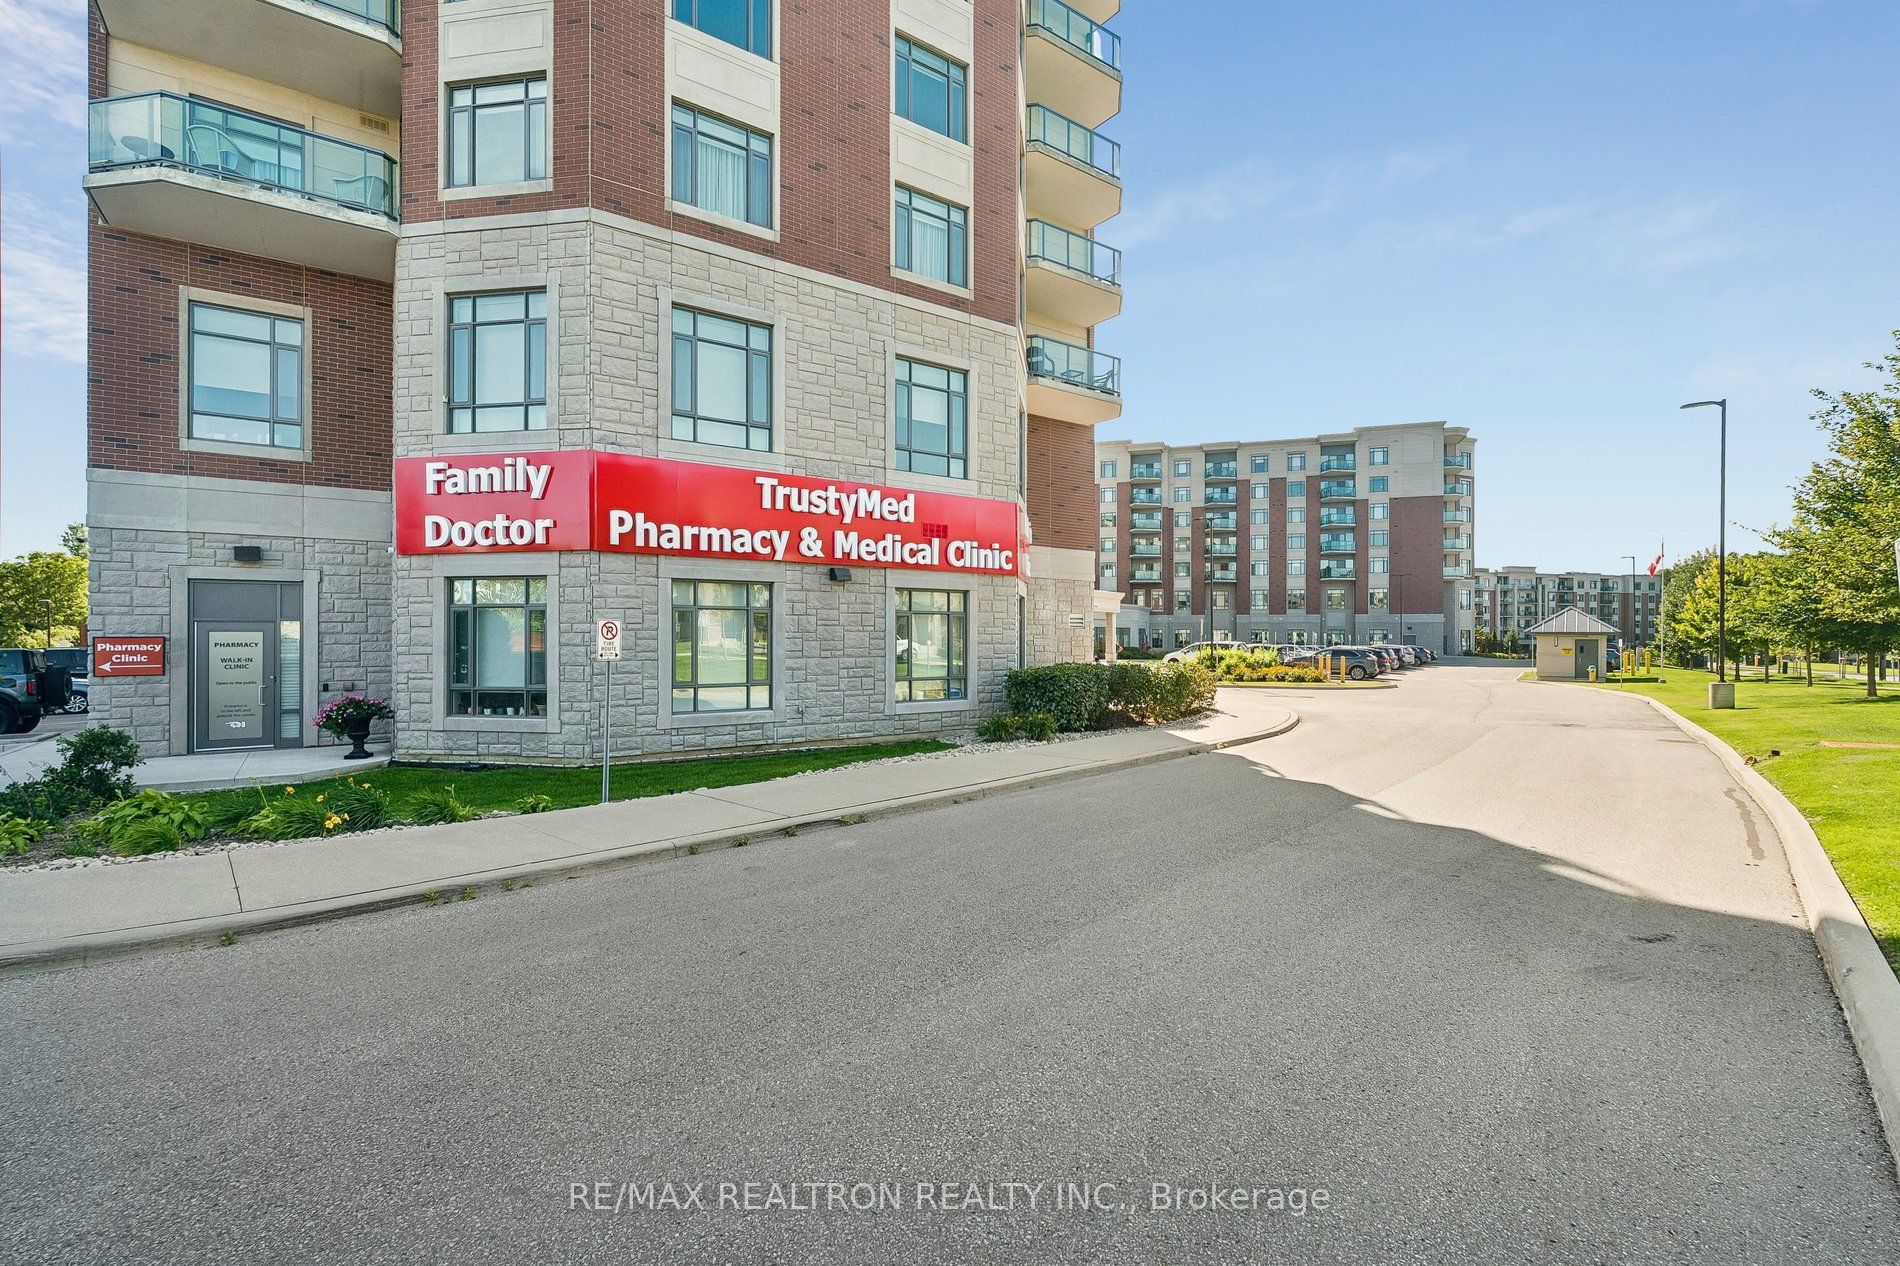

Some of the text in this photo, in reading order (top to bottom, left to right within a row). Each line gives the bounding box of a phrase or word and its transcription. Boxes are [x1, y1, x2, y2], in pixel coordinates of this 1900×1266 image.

[425, 456, 553, 500] Family
[755, 476, 916, 524] TrustyMed
[424, 513, 555, 548] Doctor
[609, 509, 790, 561] Pharmacy
[799, 526, 826, 558] &
[833, 530, 940, 566] Medical
[946, 540, 1013, 571] Clinic
[97, 643, 162, 652] Pharmacy
[111, 653, 148, 662] Clinic
